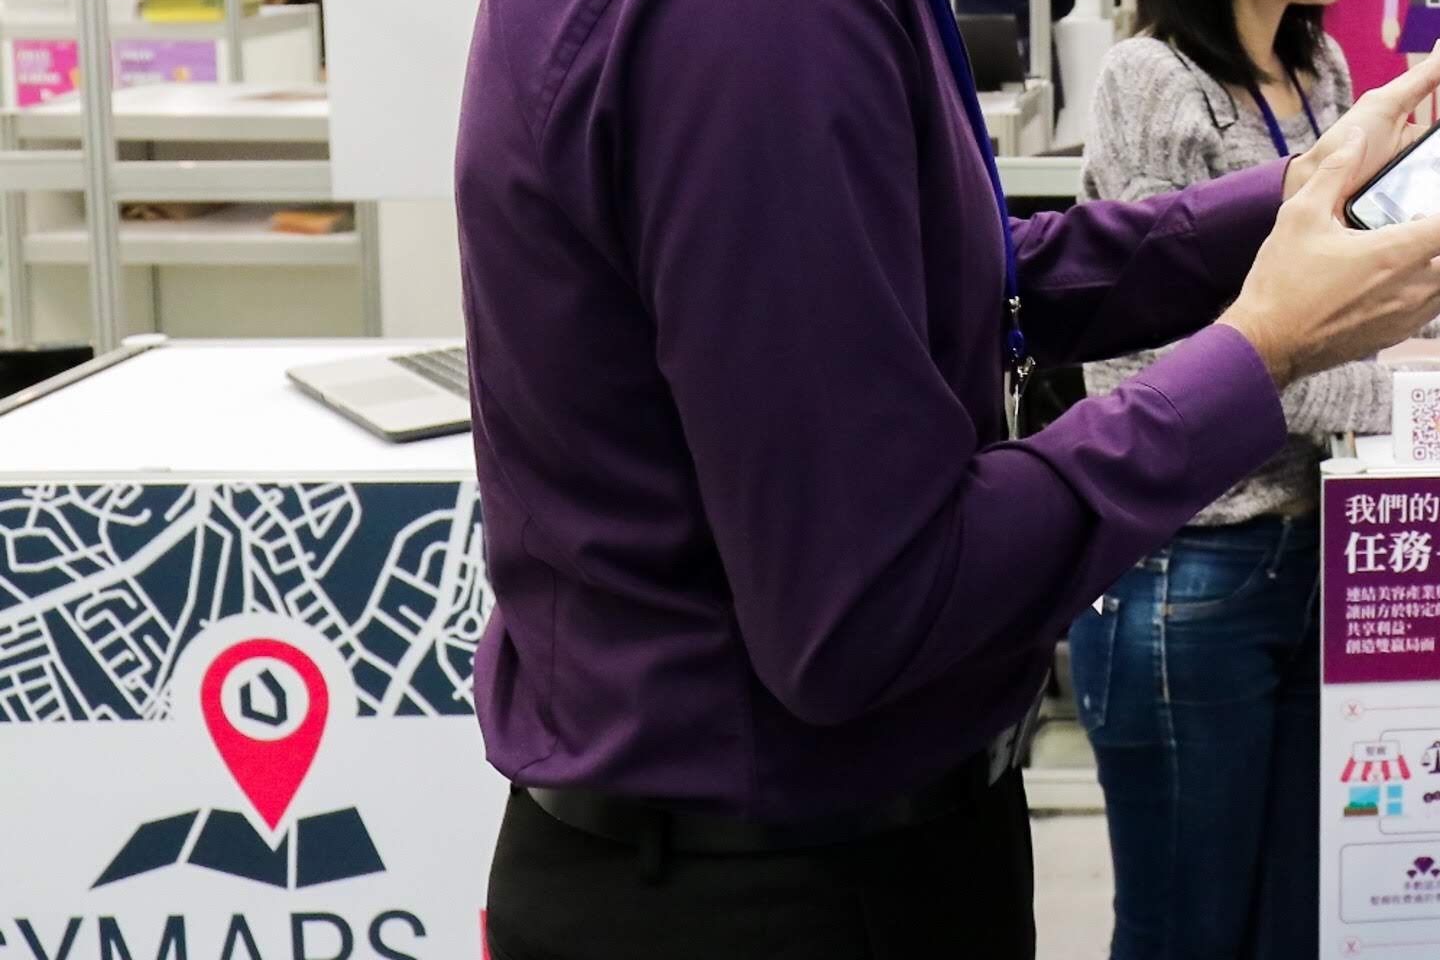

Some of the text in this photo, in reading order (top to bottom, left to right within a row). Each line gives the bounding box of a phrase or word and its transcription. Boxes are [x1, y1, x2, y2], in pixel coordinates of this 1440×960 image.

[1345, 493, 1440, 525] 我們的
[1344, 530, 1433, 575] 任務
